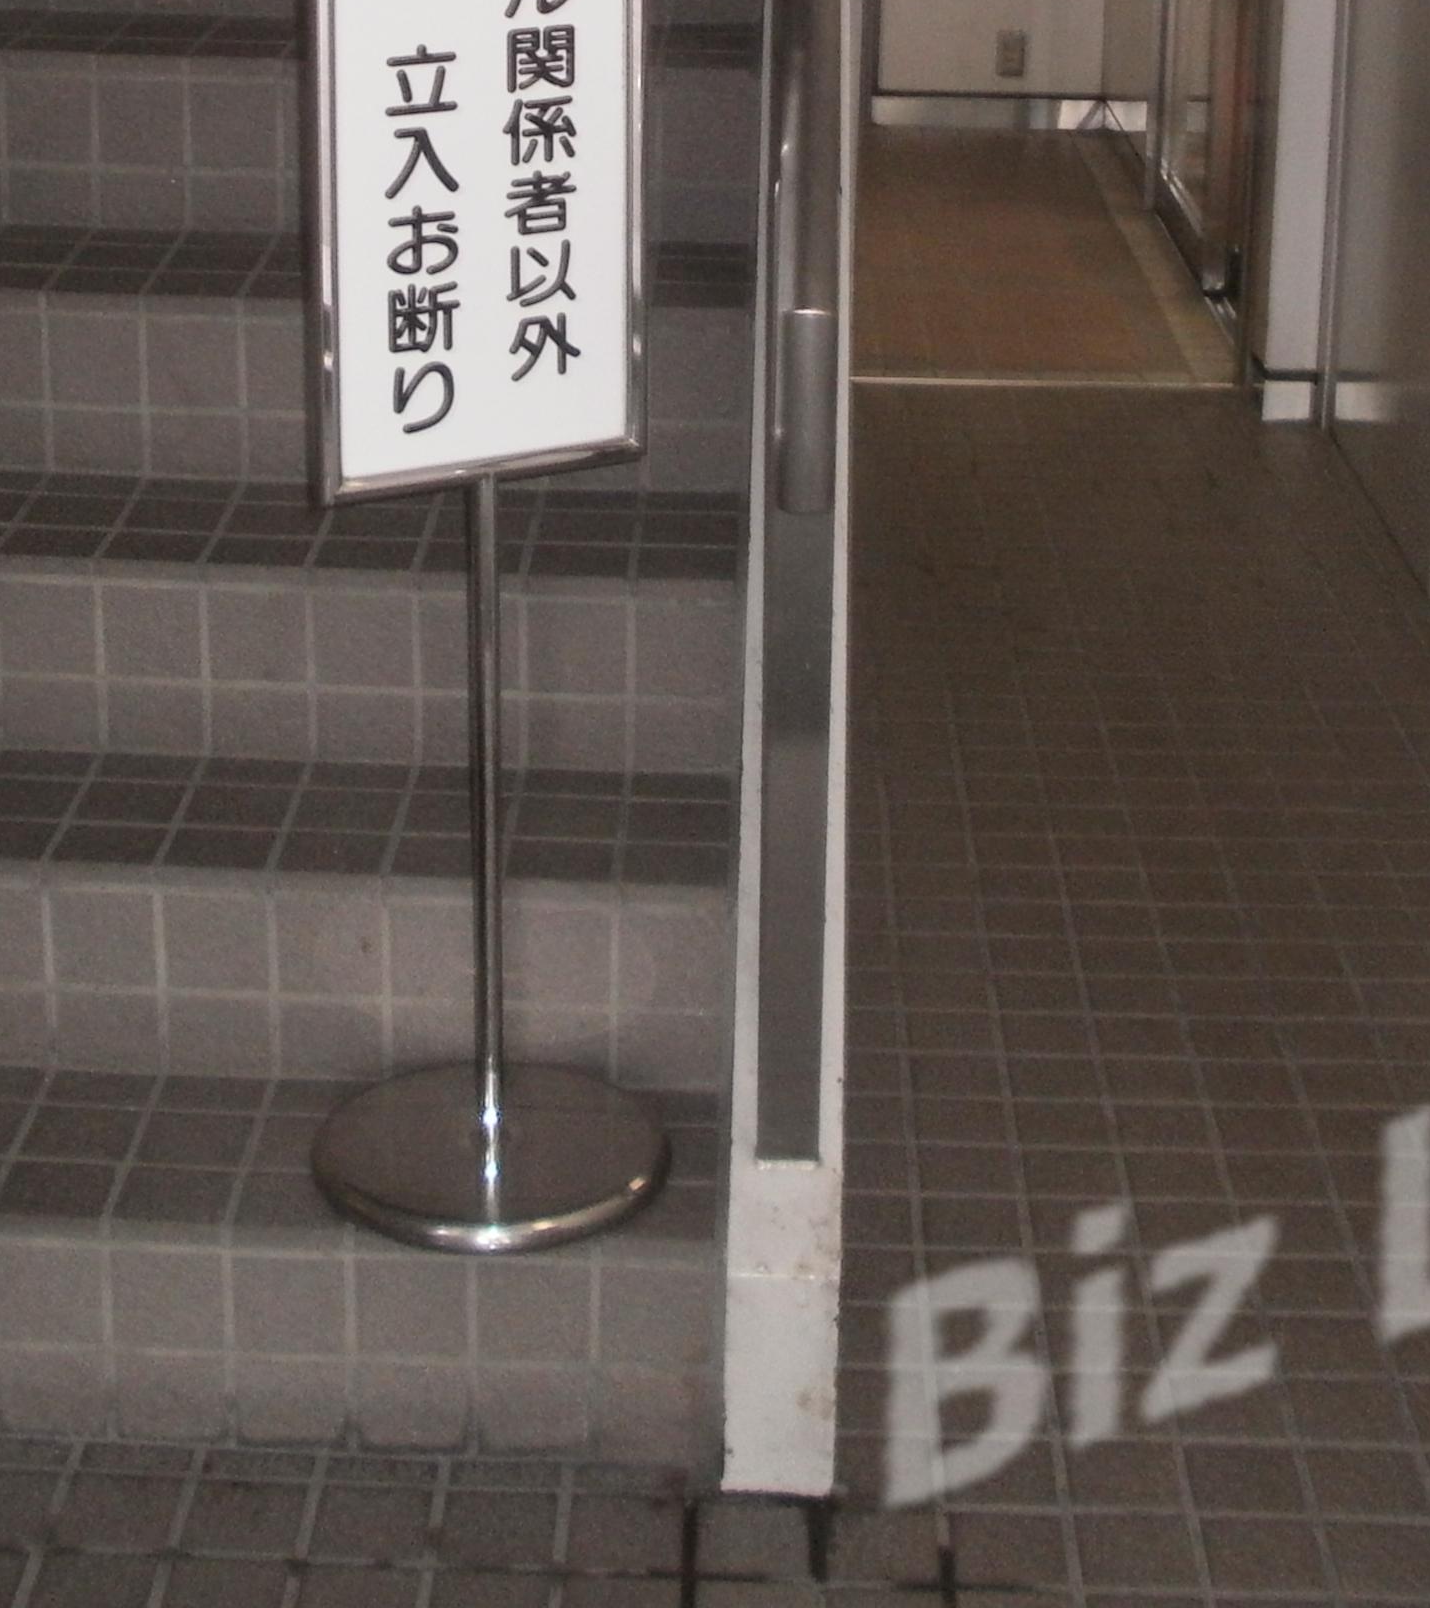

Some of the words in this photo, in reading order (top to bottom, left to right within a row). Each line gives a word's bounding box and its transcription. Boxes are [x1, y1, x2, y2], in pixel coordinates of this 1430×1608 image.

[384, 43, 461, 434] 立入お断り
